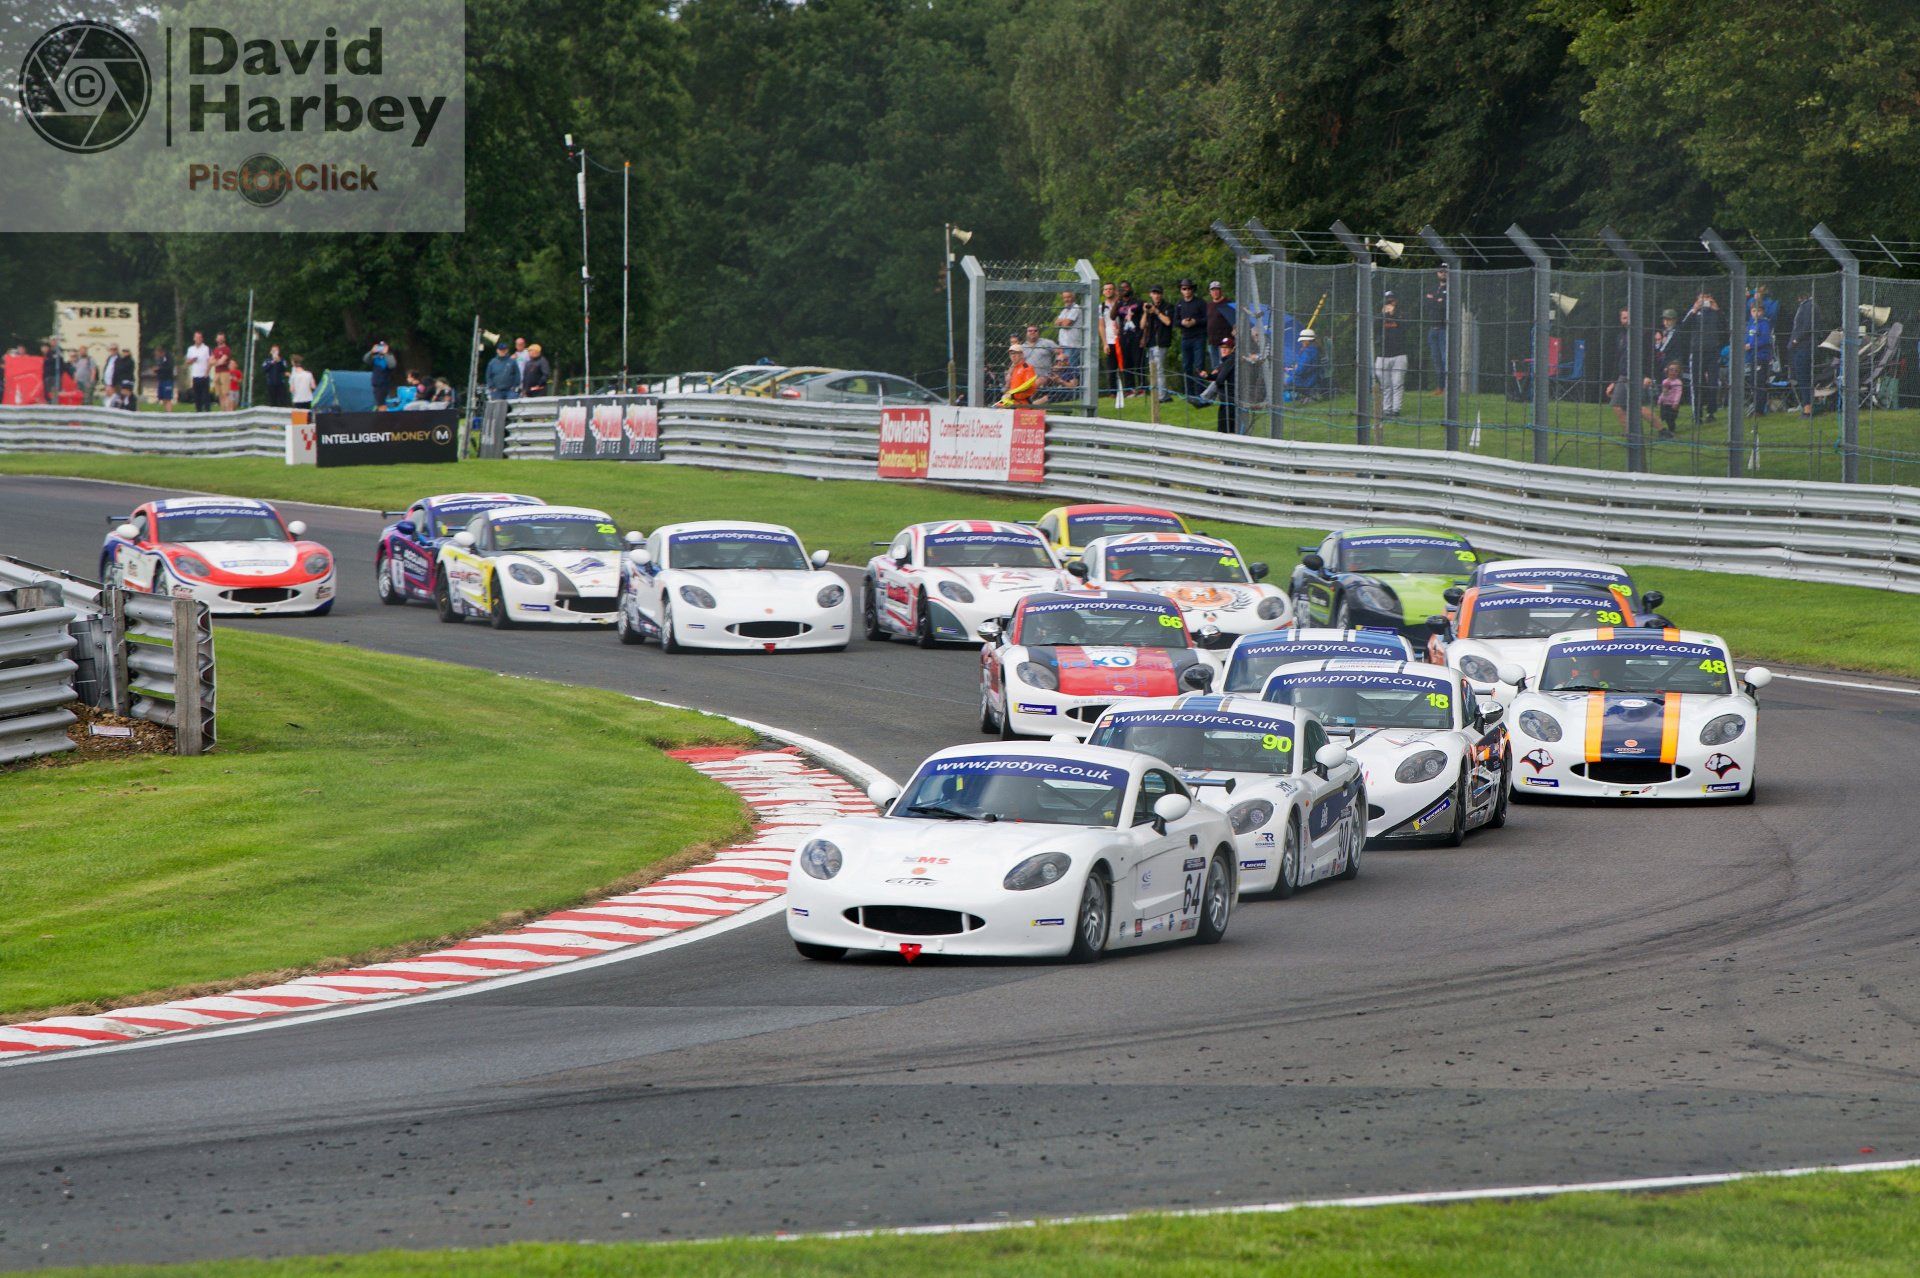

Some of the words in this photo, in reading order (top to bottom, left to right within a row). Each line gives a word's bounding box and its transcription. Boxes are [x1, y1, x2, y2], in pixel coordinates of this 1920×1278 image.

[881, 412, 929, 443] Rowlands
[976, 419, 1003, 438] Domestic
[880, 449, 916, 473] Contracting
[164, 508, 269, 519] www.protyre.co.uk
[1075, 515, 1175, 525] www.protyre.co.uk
[678, 530, 789, 543] www.protyre.co.uk
[934, 534, 1044, 546] www.protyre.co.uk
[1350, 537, 1462, 548] www.protyre.co.uk
[1219, 556, 1240, 568] 44
[1495, 570, 1620, 582] www.protyre.co.uk
[1035, 600, 1167, 614] www.protyre.co.uk
[1479, 596, 1612, 608] www.protyre.co.uk
[1158, 614, 1184, 629] 66
[1596, 610, 1622, 625] 39
[1247, 643, 1393, 657] www.protyre.co.uk
[1562, 642, 1712, 656] www.protyre.co.uk
[1699, 659, 1727, 675] 48
[1283, 673, 1437, 690] www.protyre.co.uk
[1426, 692, 1449, 709] 18
[1113, 711, 1280, 732] www.protyre.co.uk
[1262, 734, 1292, 753] 90
[936, 758, 1113, 781] www.protyre.co.uk
[1183, 872, 1202, 915] 64
